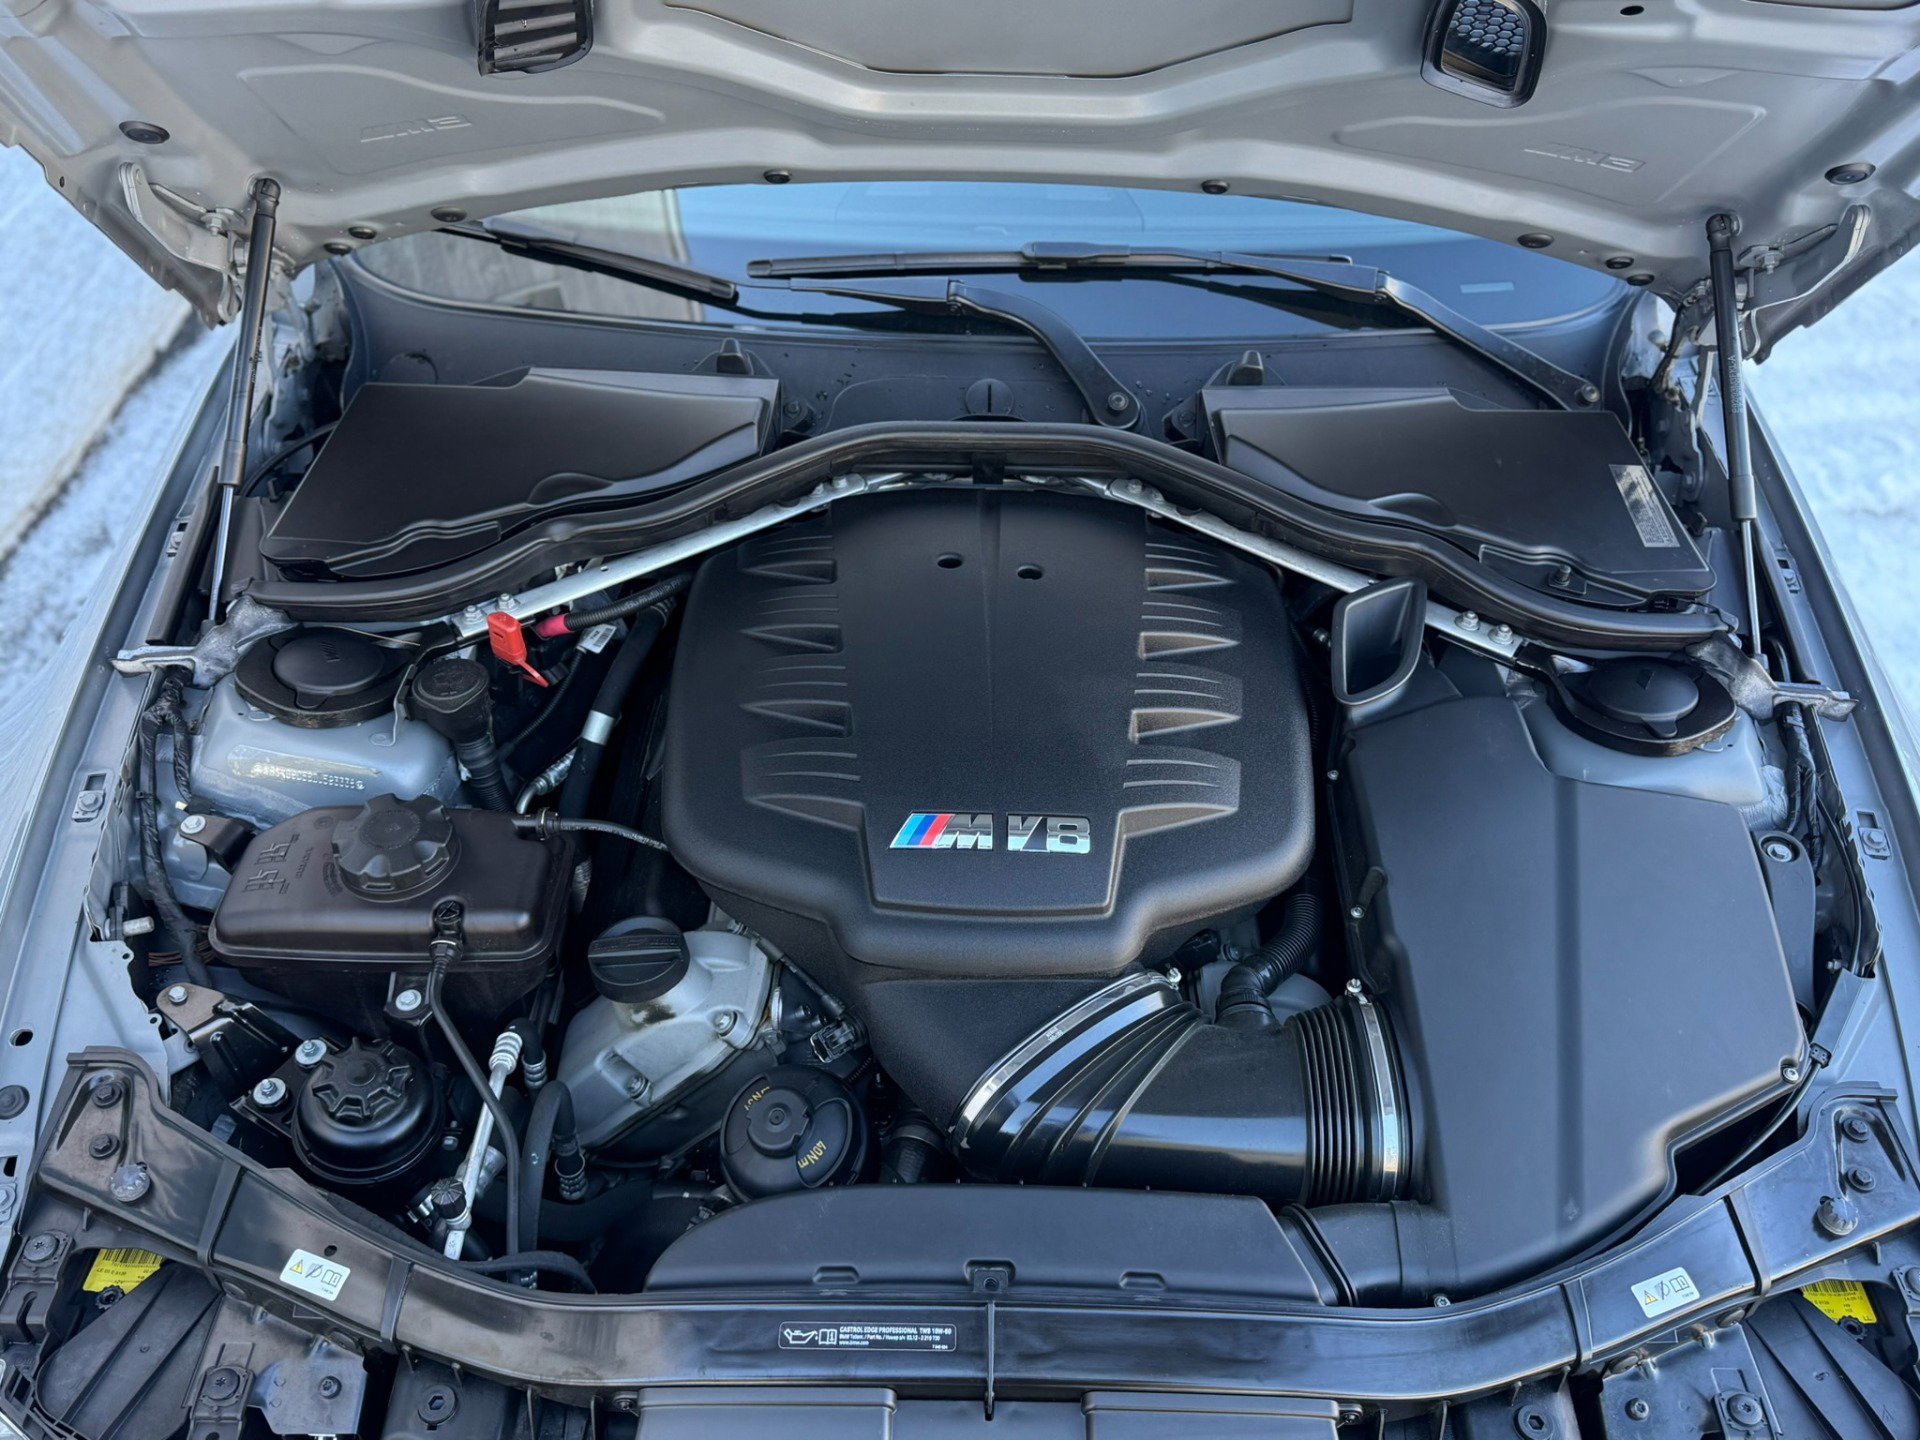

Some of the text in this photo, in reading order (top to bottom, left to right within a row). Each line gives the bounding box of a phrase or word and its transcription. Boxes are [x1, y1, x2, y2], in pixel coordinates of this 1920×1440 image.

[1007, 814, 1090, 853] V8
[797, 1140, 827, 1169] 40Nm
[879, 1327, 918, 1335] PROFESSIONAL
